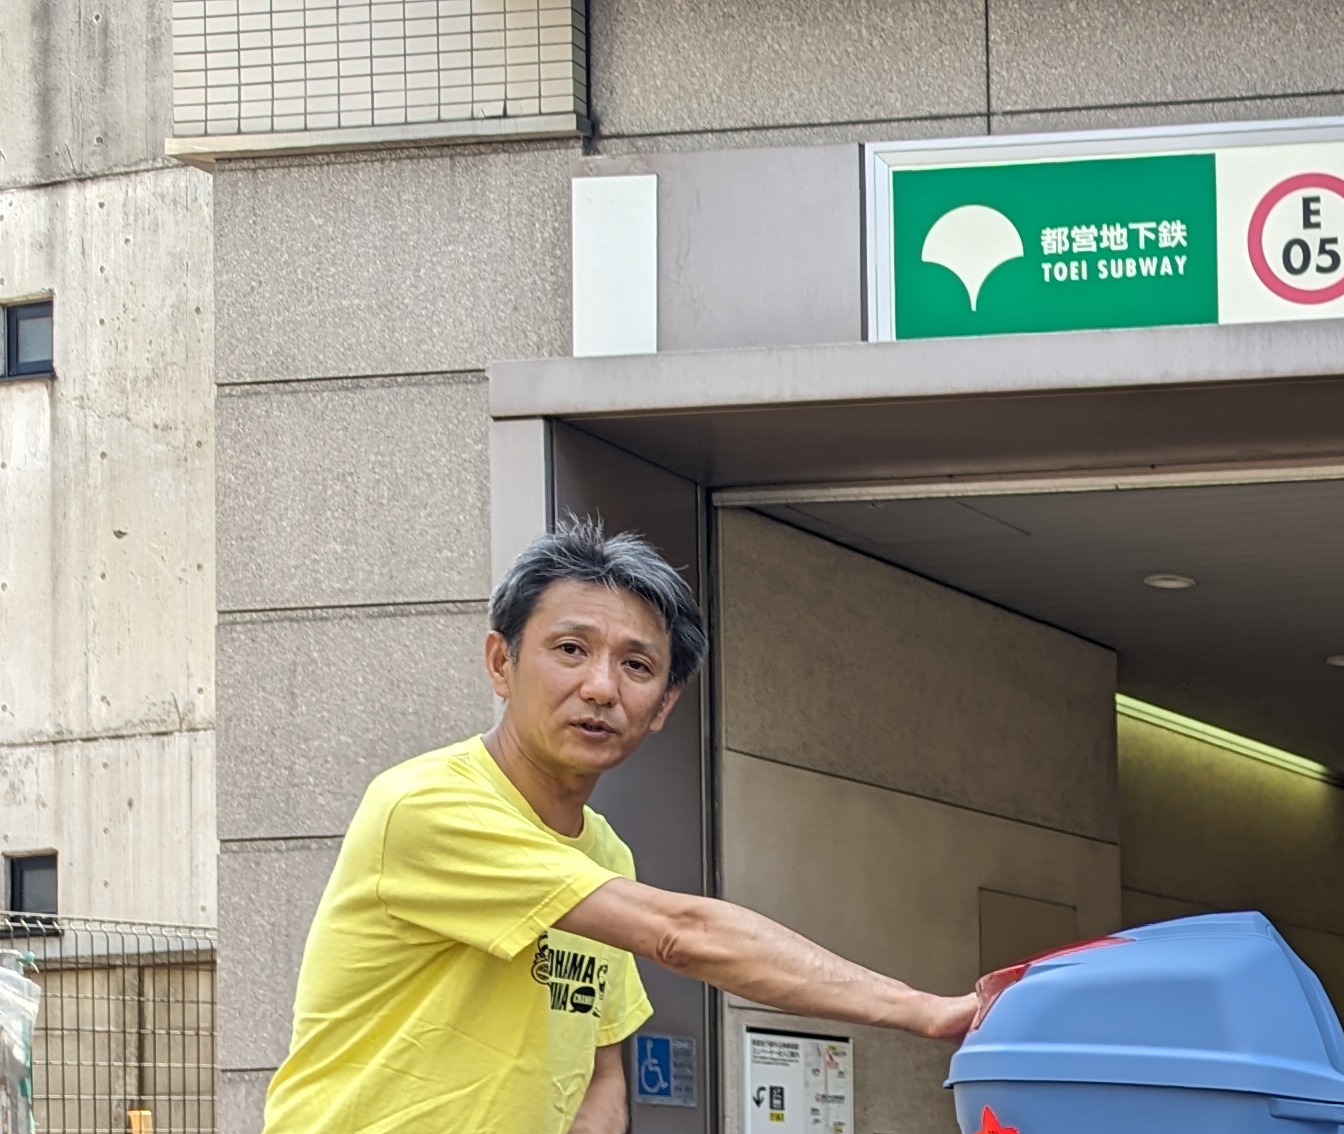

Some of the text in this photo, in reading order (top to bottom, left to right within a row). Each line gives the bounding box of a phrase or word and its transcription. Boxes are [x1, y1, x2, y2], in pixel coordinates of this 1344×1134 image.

[1301, 194, 1322, 230] E
[1040, 219, 1188, 256] 都営地下鉄
[1041, 254, 1188, 283] TOEI SUBWAY
[1281, 236, 1342, 277] 05
